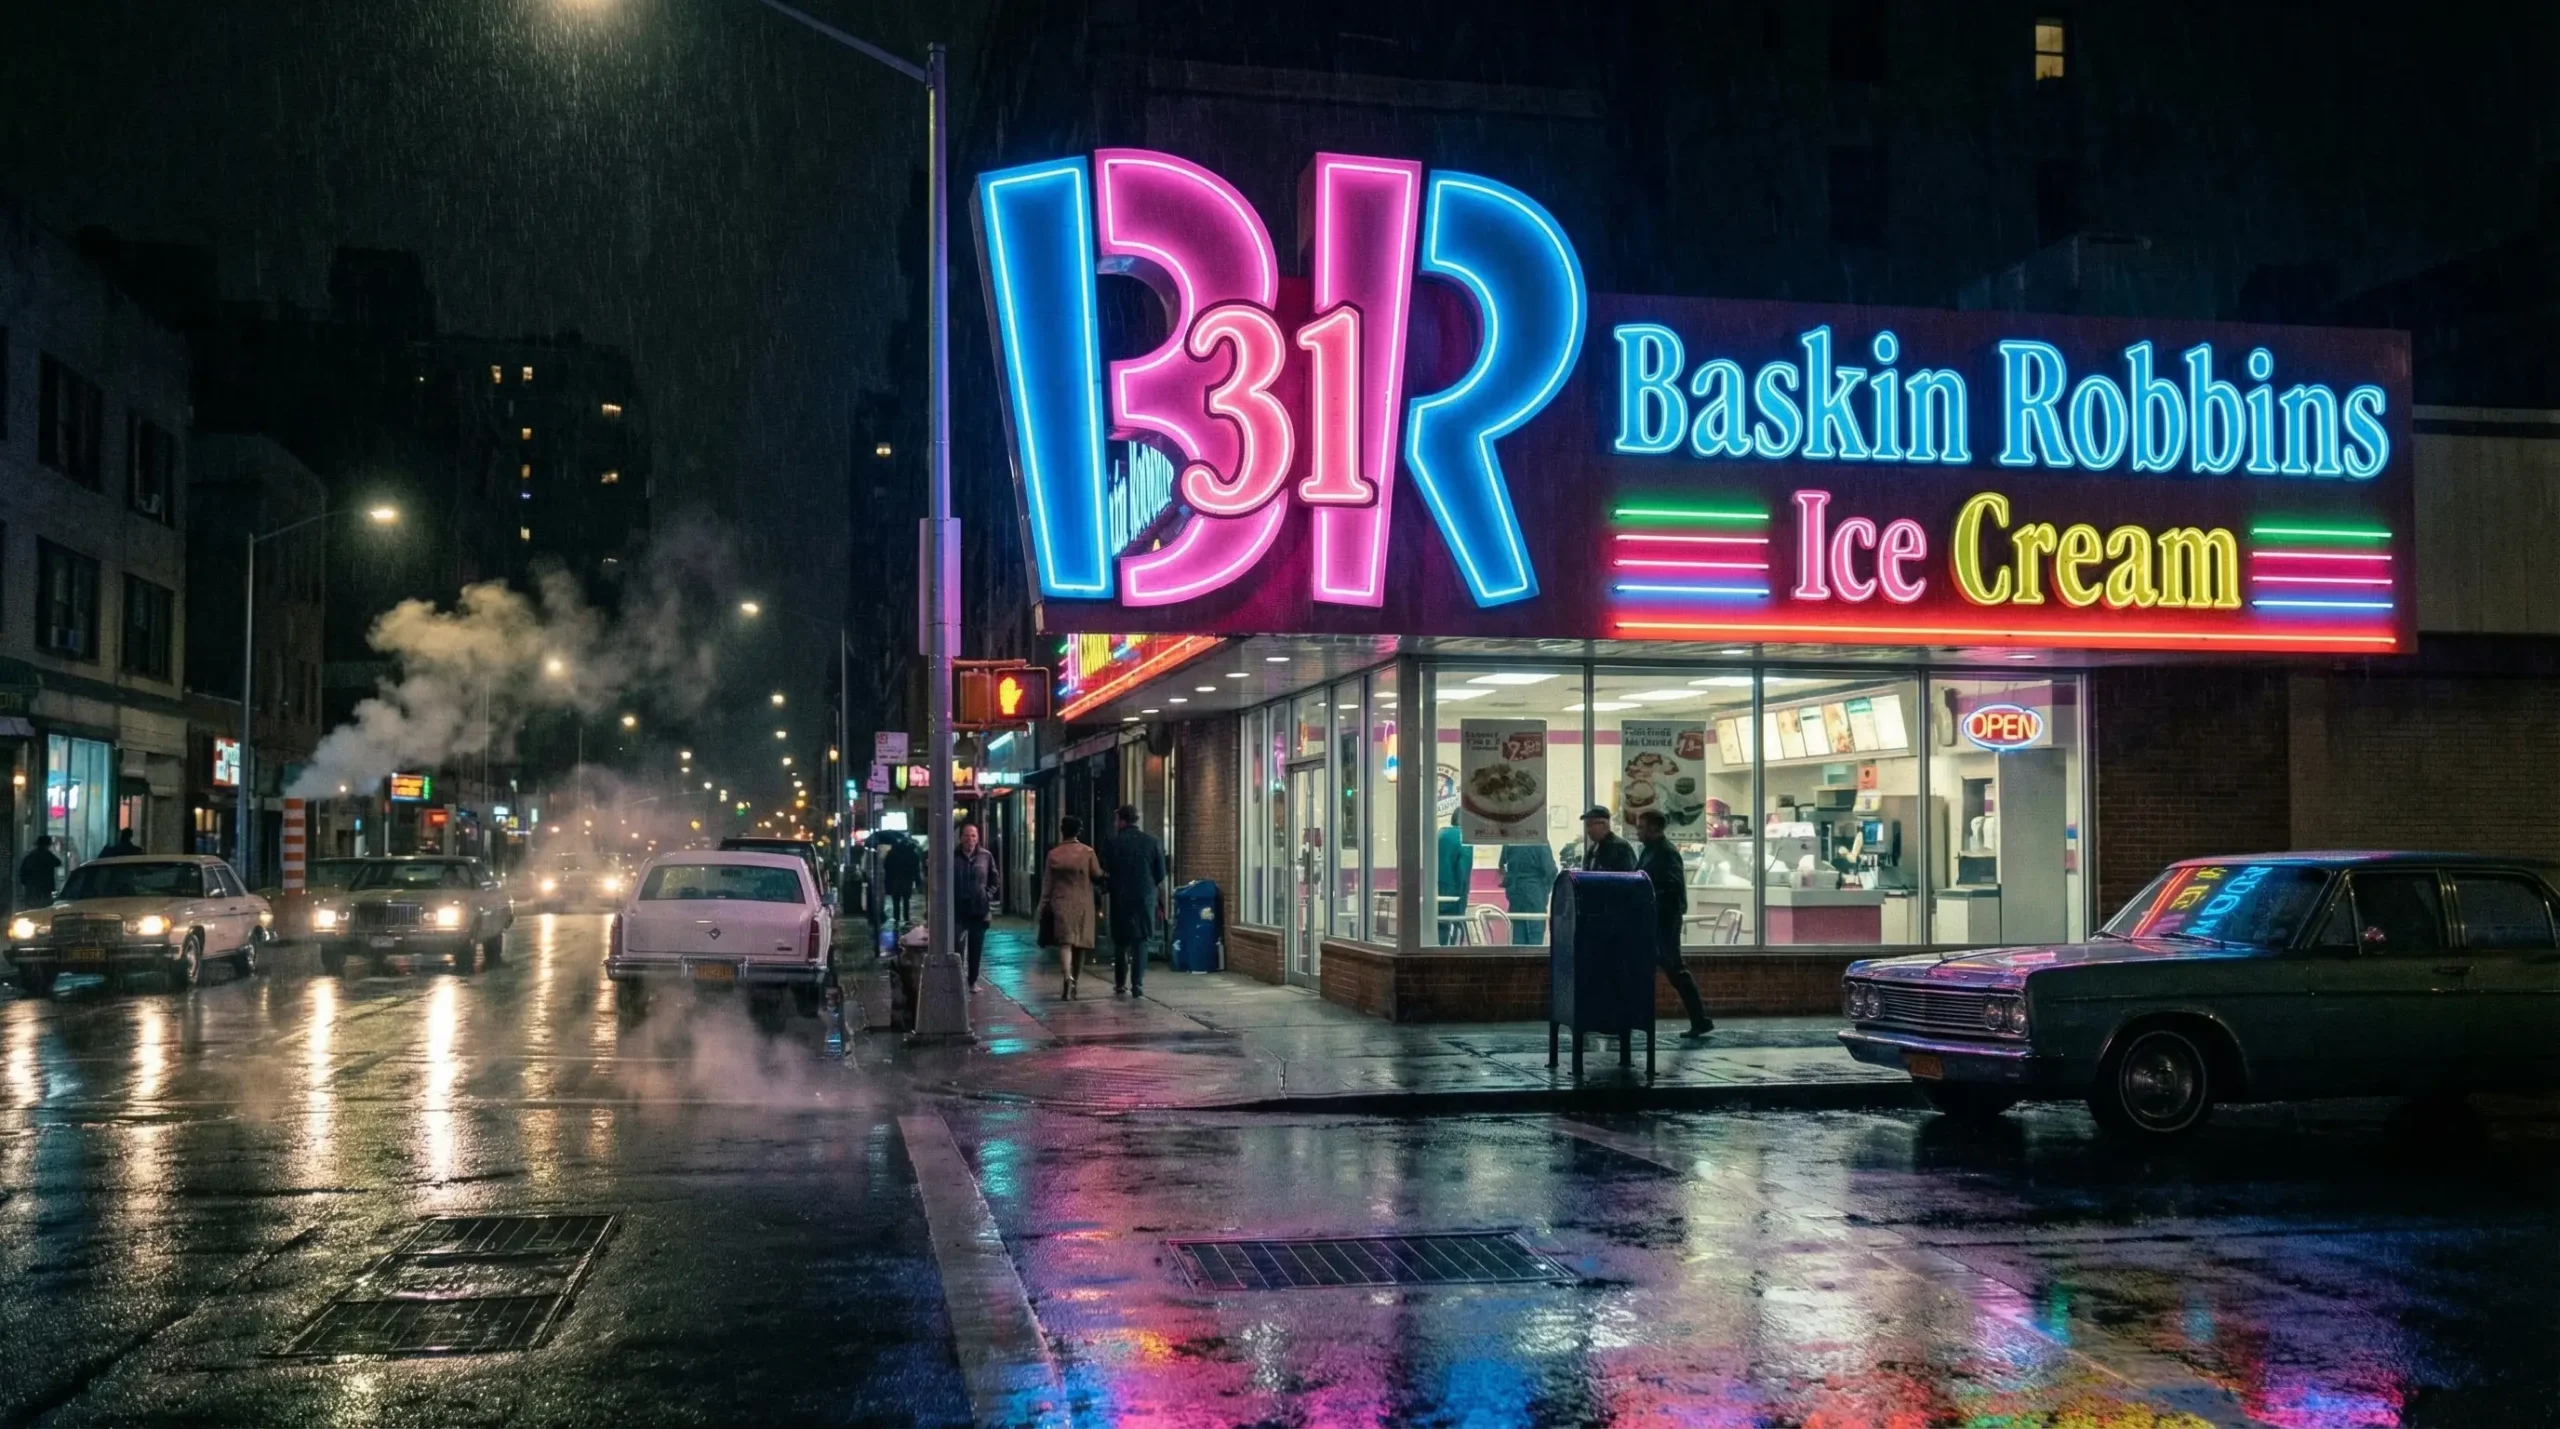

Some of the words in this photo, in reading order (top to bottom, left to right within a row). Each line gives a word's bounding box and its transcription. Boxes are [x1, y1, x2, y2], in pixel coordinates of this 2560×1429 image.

[978, 148, 1587, 608] BR
[1180, 304, 1376, 516] 31
[1613, 323, 1972, 464] Baskin
[1998, 340, 2390, 480] Robbins
[1792, 490, 1928, 604] Ice
[1952, 491, 2243, 609] Cream
[1969, 714, 2037, 740] OPEN
